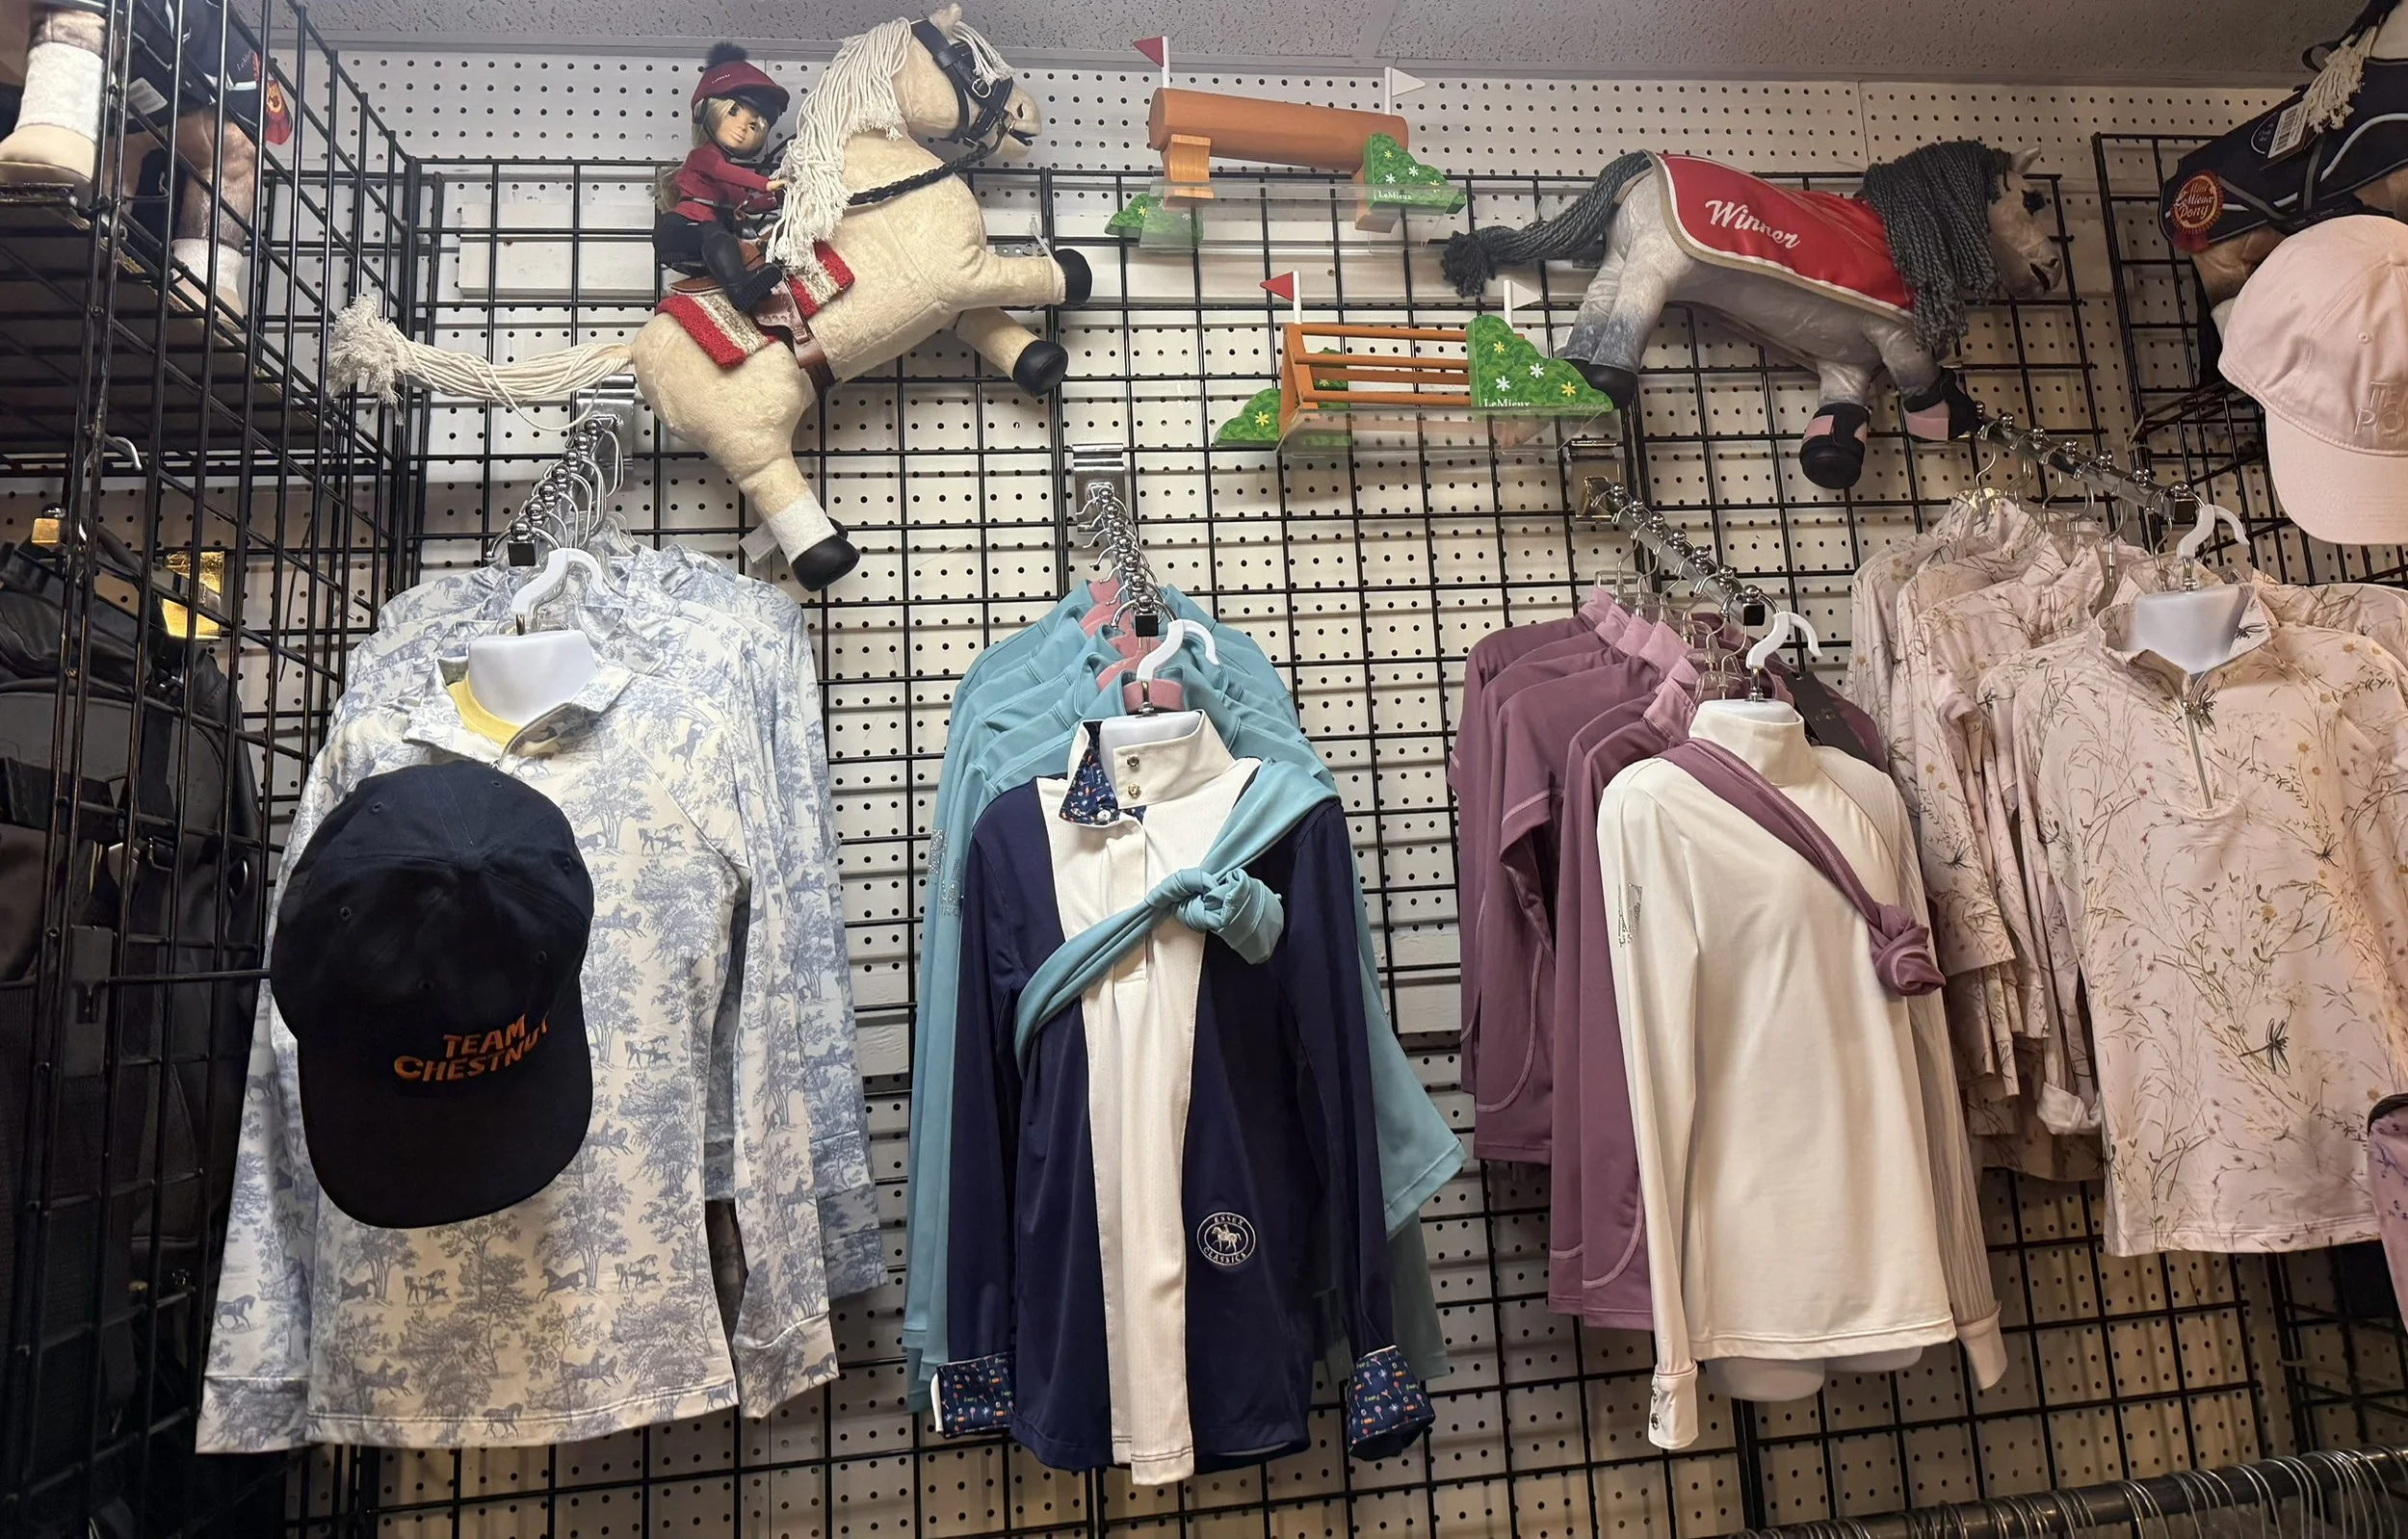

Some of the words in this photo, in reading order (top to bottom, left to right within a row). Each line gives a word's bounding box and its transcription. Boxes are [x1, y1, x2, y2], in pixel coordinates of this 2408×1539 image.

[1377, 189, 1413, 200] LeMieux
[1704, 199, 1801, 249] Winner
[442, 1013, 526, 1058] TEAM
[1214, 1214, 1244, 1227] ESSEX
[1203, 1246, 1247, 1264] CLASSICS
